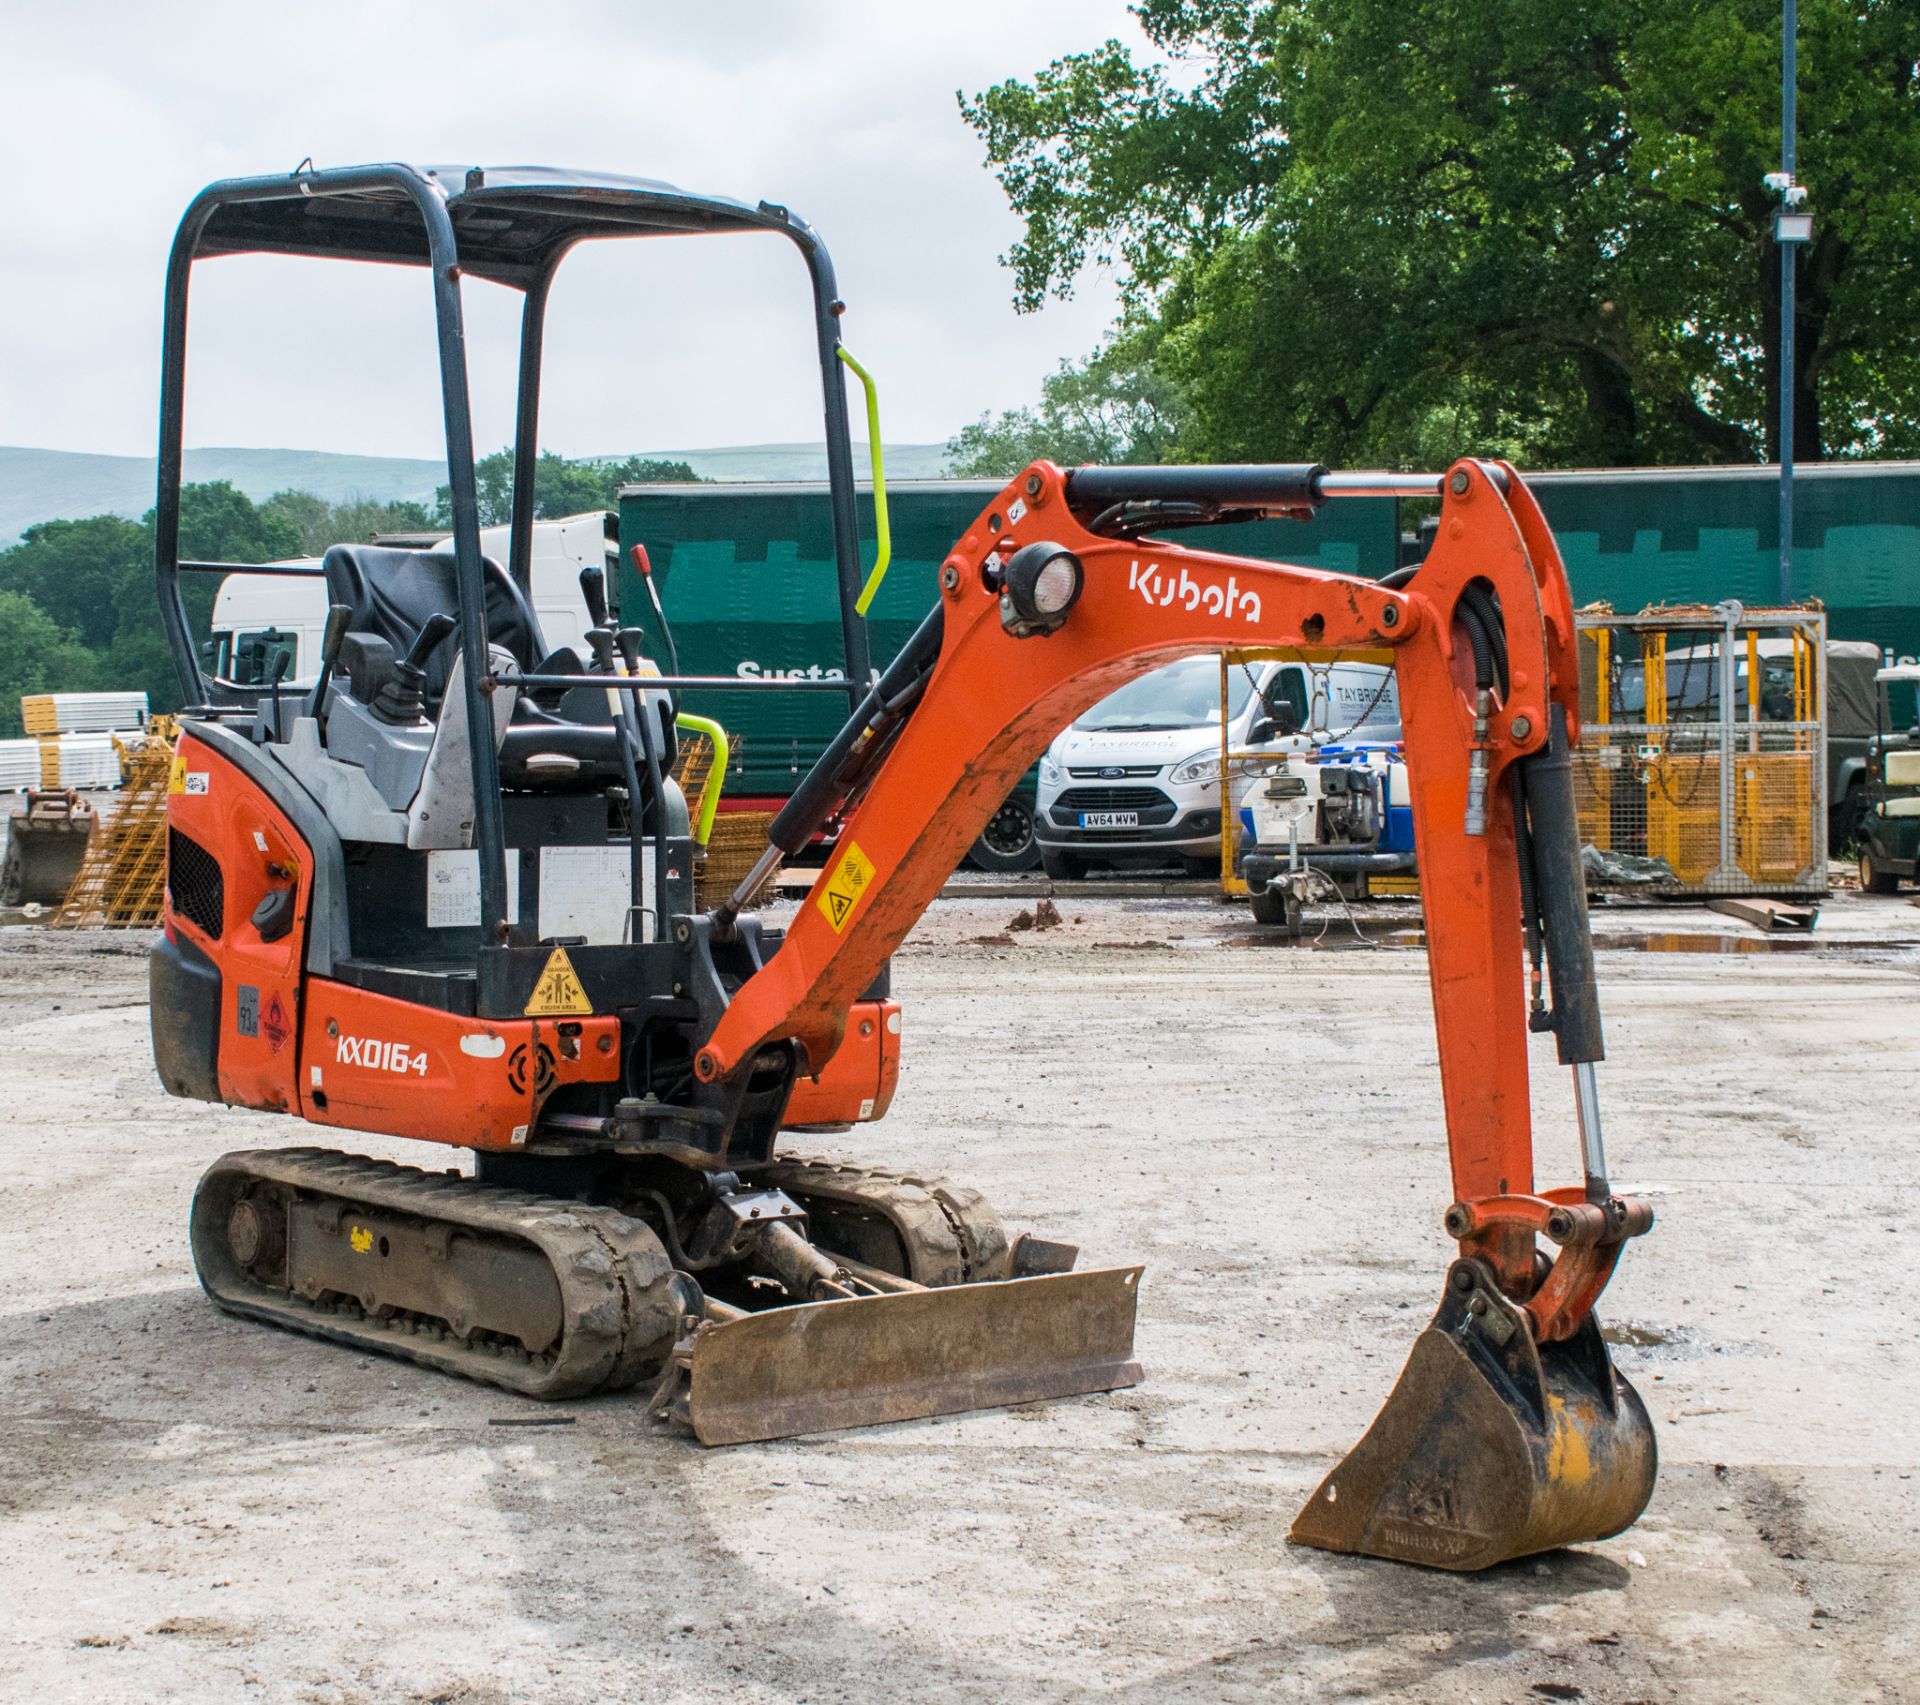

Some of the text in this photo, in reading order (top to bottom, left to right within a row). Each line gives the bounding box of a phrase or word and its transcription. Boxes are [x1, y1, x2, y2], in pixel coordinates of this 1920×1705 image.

[1129, 560, 1261, 623] Kubota
[1087, 813, 1137, 826] AV64 MVM
